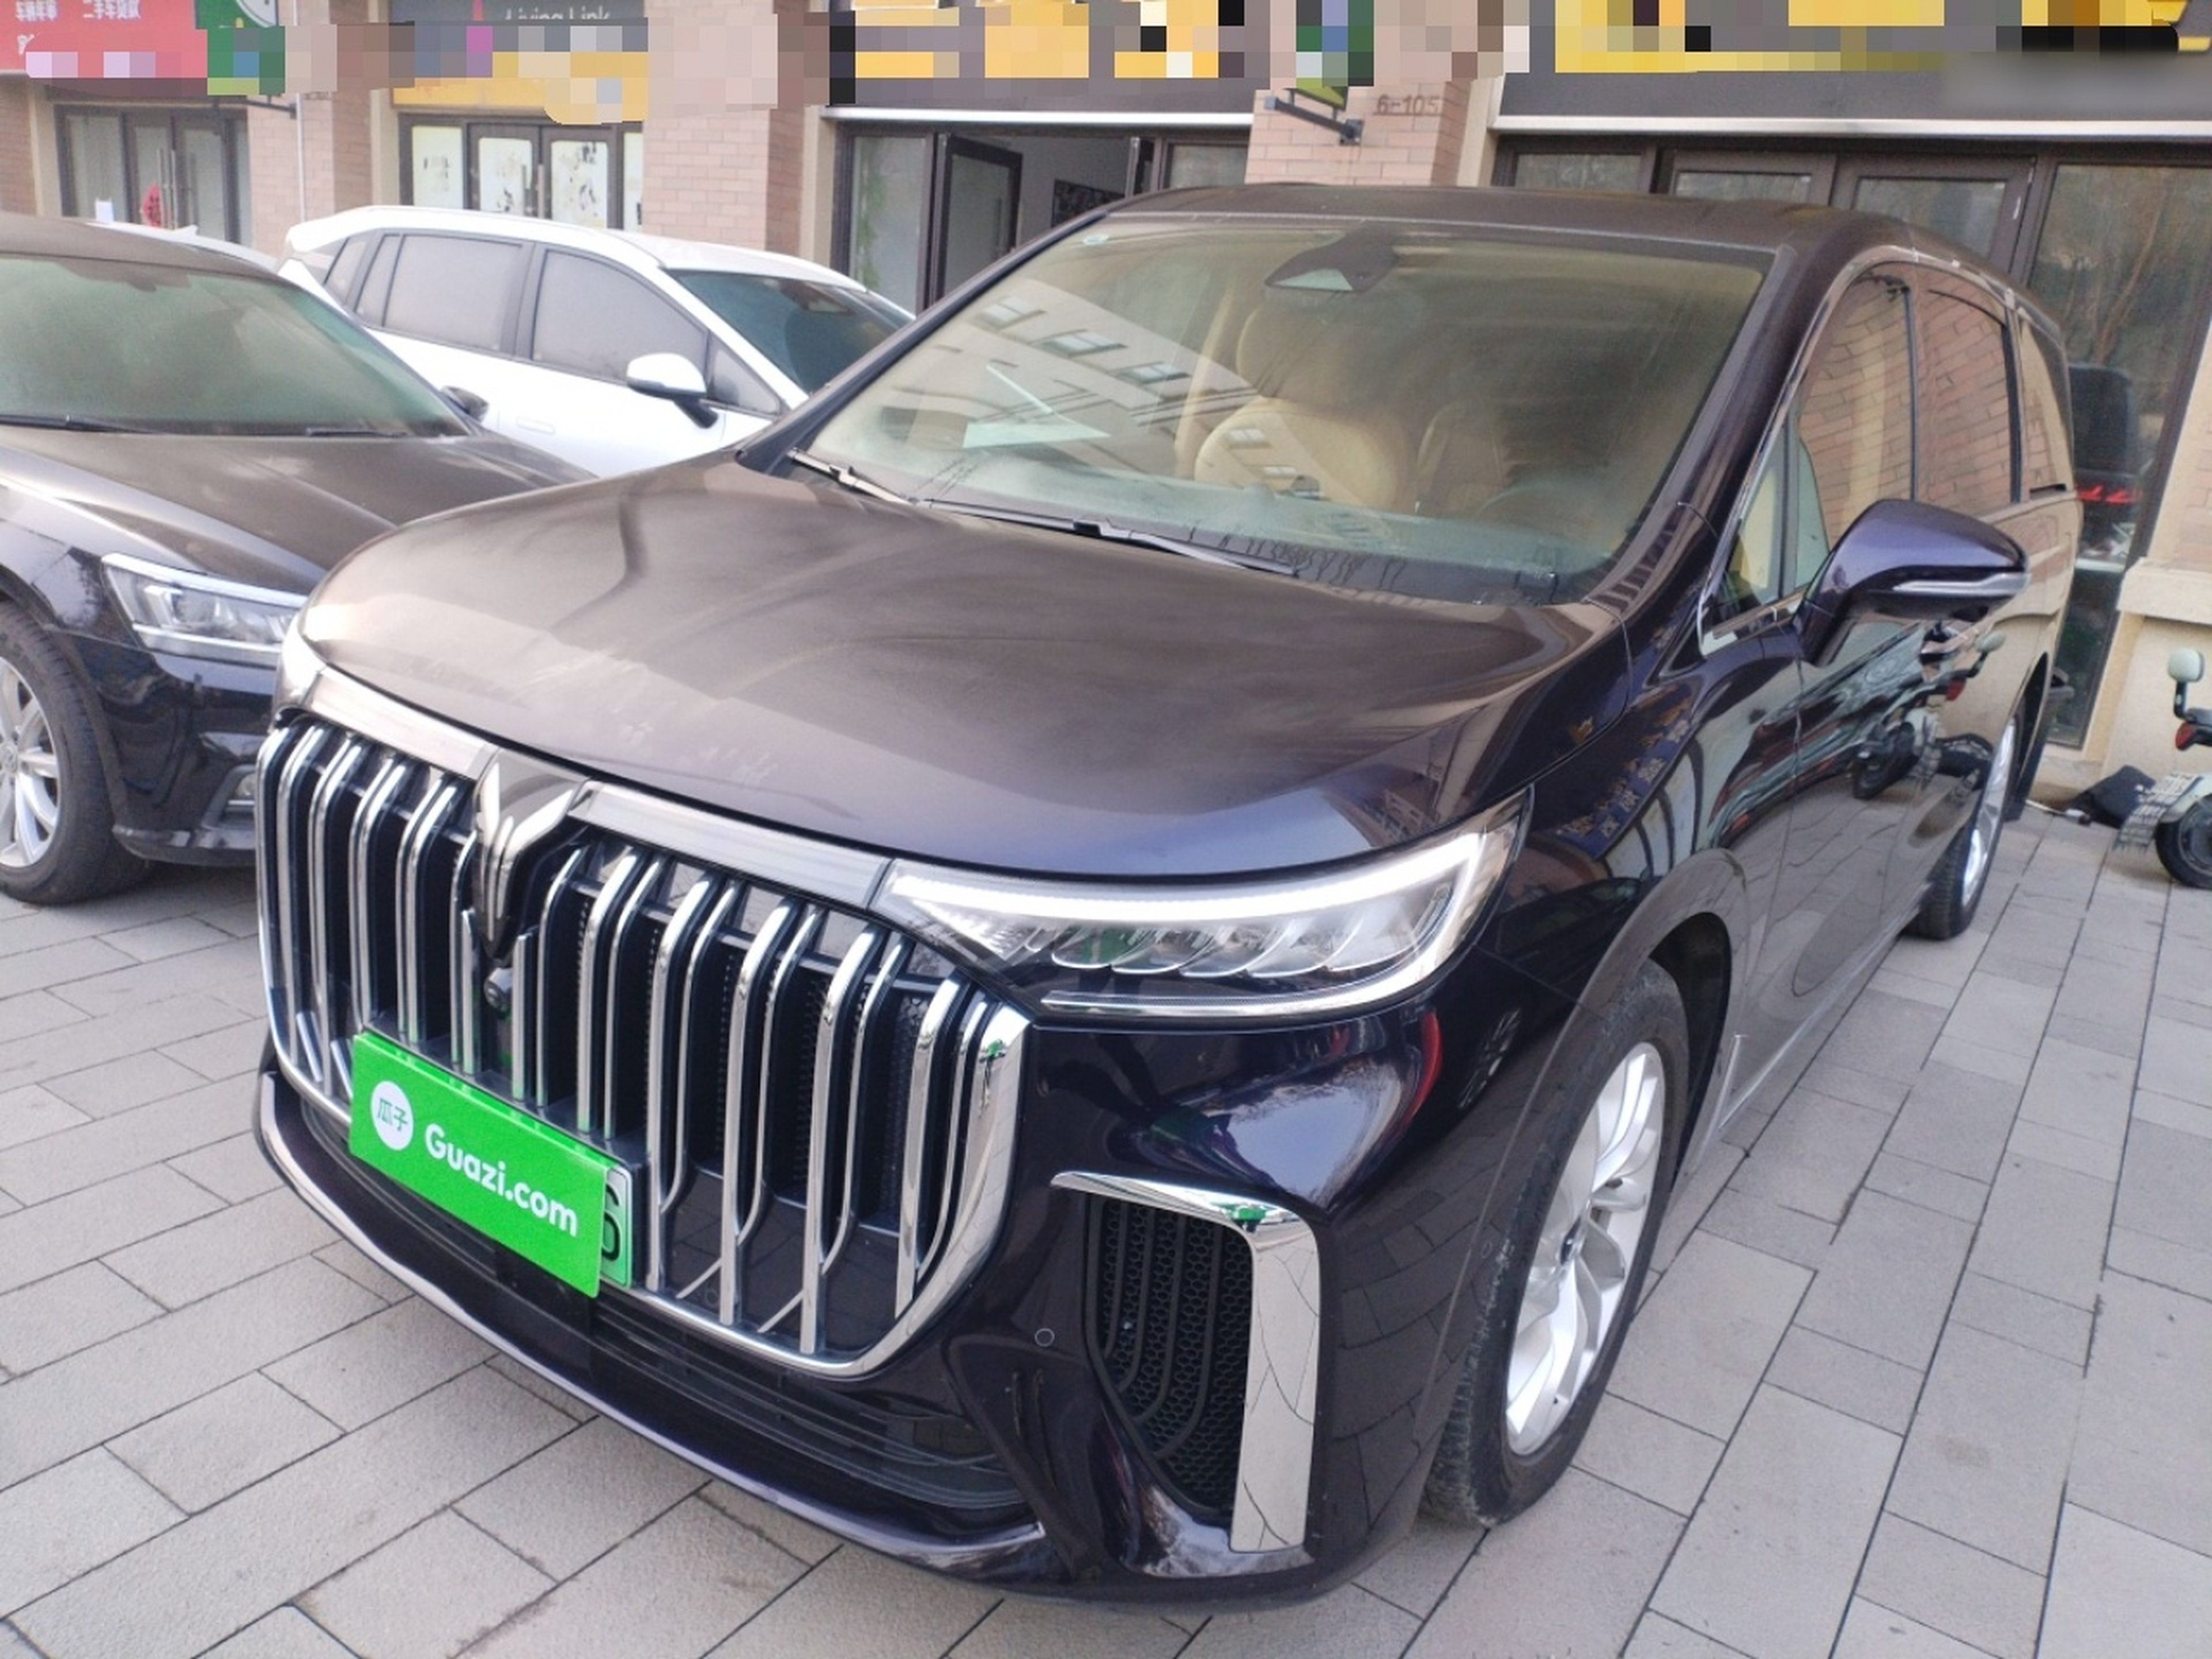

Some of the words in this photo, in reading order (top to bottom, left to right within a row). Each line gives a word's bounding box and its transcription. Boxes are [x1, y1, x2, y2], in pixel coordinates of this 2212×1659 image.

[1377, 94, 1440, 115] 6-105
[378, 1097, 407, 1132] 瓜子
[425, 1123, 578, 1237] Guazi.com
